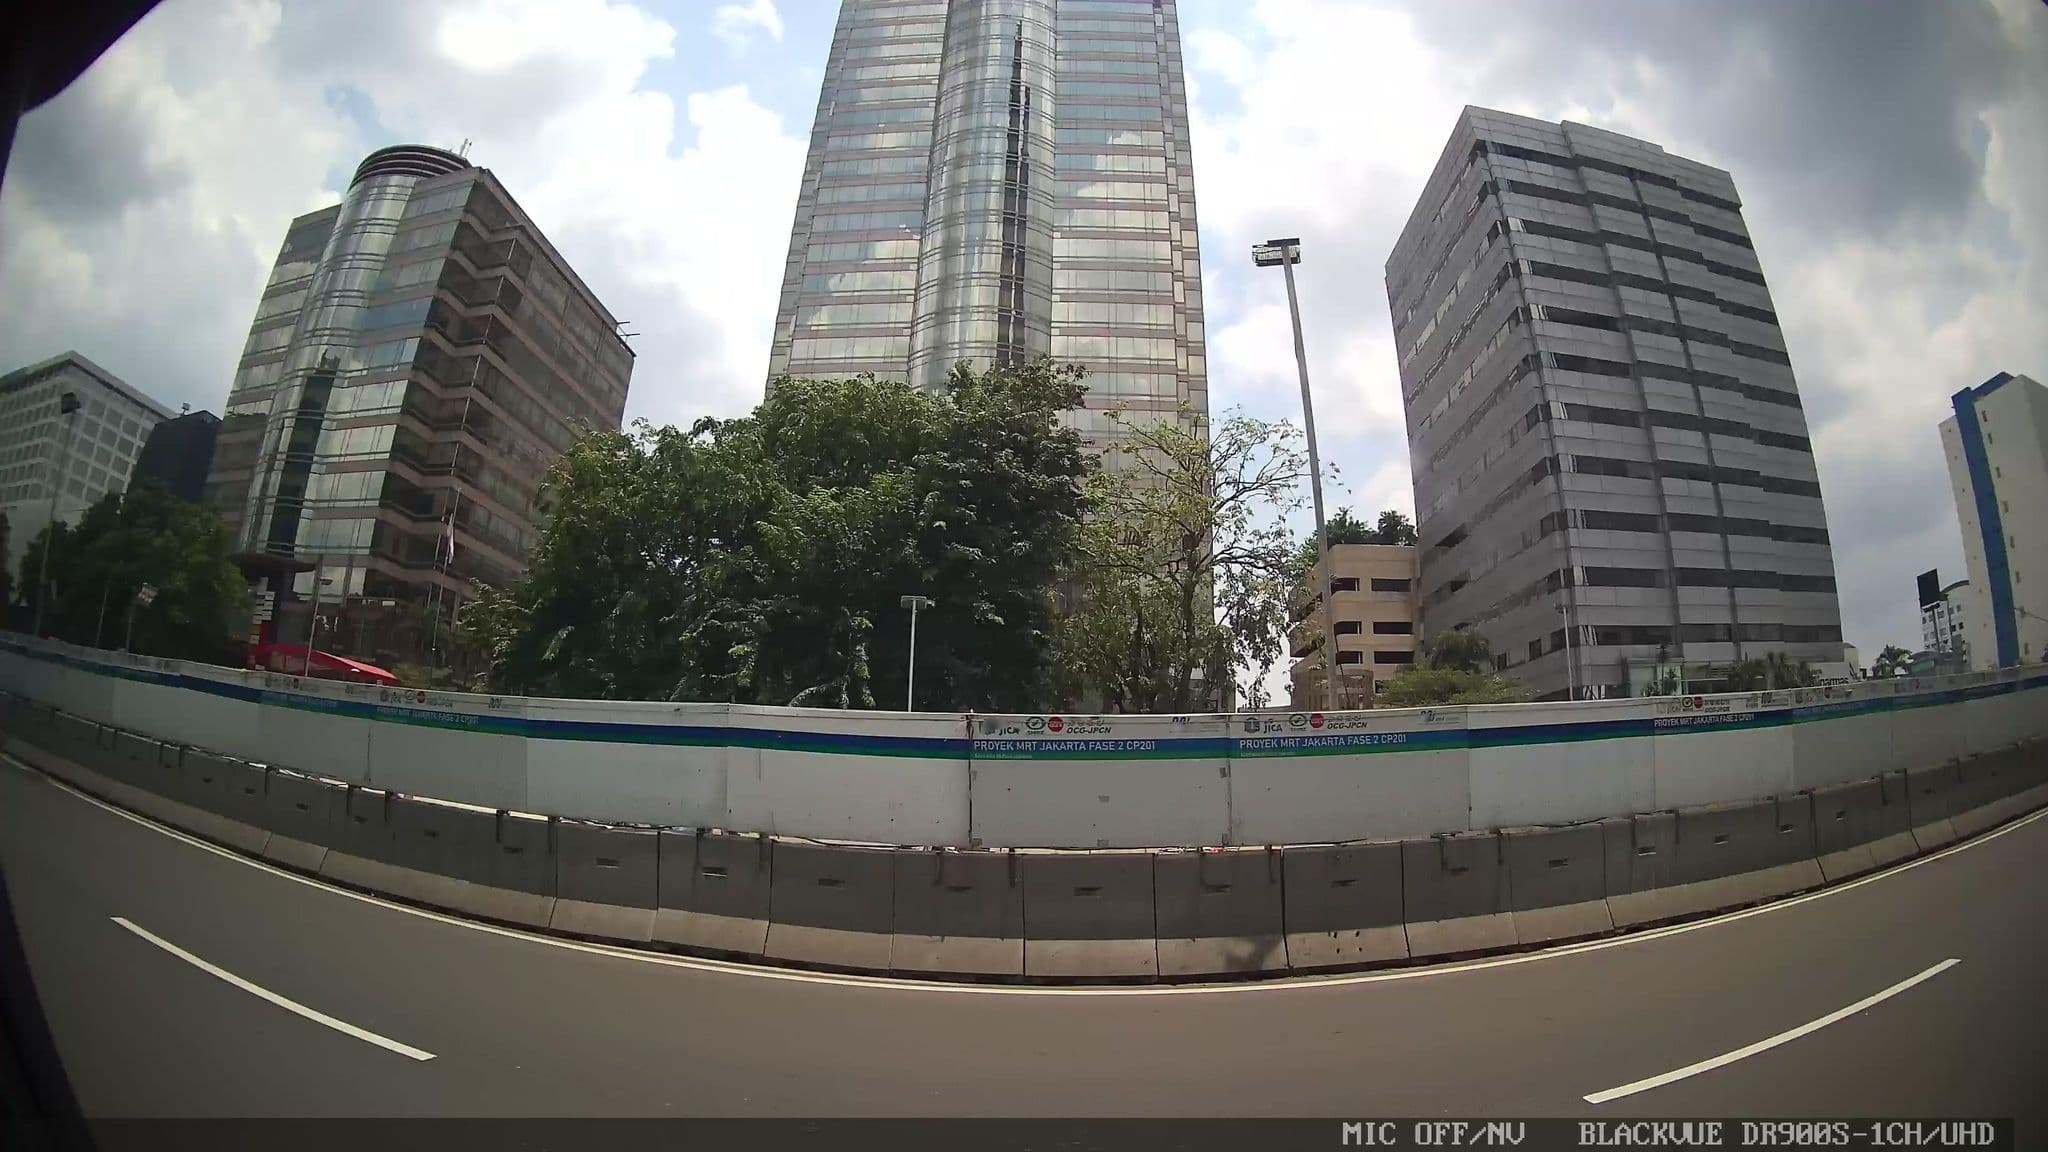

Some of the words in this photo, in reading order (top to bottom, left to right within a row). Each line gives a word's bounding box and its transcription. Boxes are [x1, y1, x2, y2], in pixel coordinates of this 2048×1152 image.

[1066, 726, 1112, 734] OCG-JPCN
[1263, 720, 1283, 734] JICA
[1326, 722, 1368, 730] OCG-JPCN
[974, 741, 1014, 751] PROYEK
[1016, 741, 1037, 751] MRT
[1039, 741, 1087, 751] JAKARTA
[1088, 741, 1116, 751] FASE
[1118, 741, 1125, 750] 2
[1126, 740, 1155, 750] CP201
[1240, 739, 1278, 749] PROYEK
[1280, 738, 1300, 748] MRT
[1302, 736, 1346, 747] JAKARTA
[1347, 735, 1372, 745] FASE
[1373, 735, 1380, 744] 2
[1381, 734, 1407, 744] CP201
